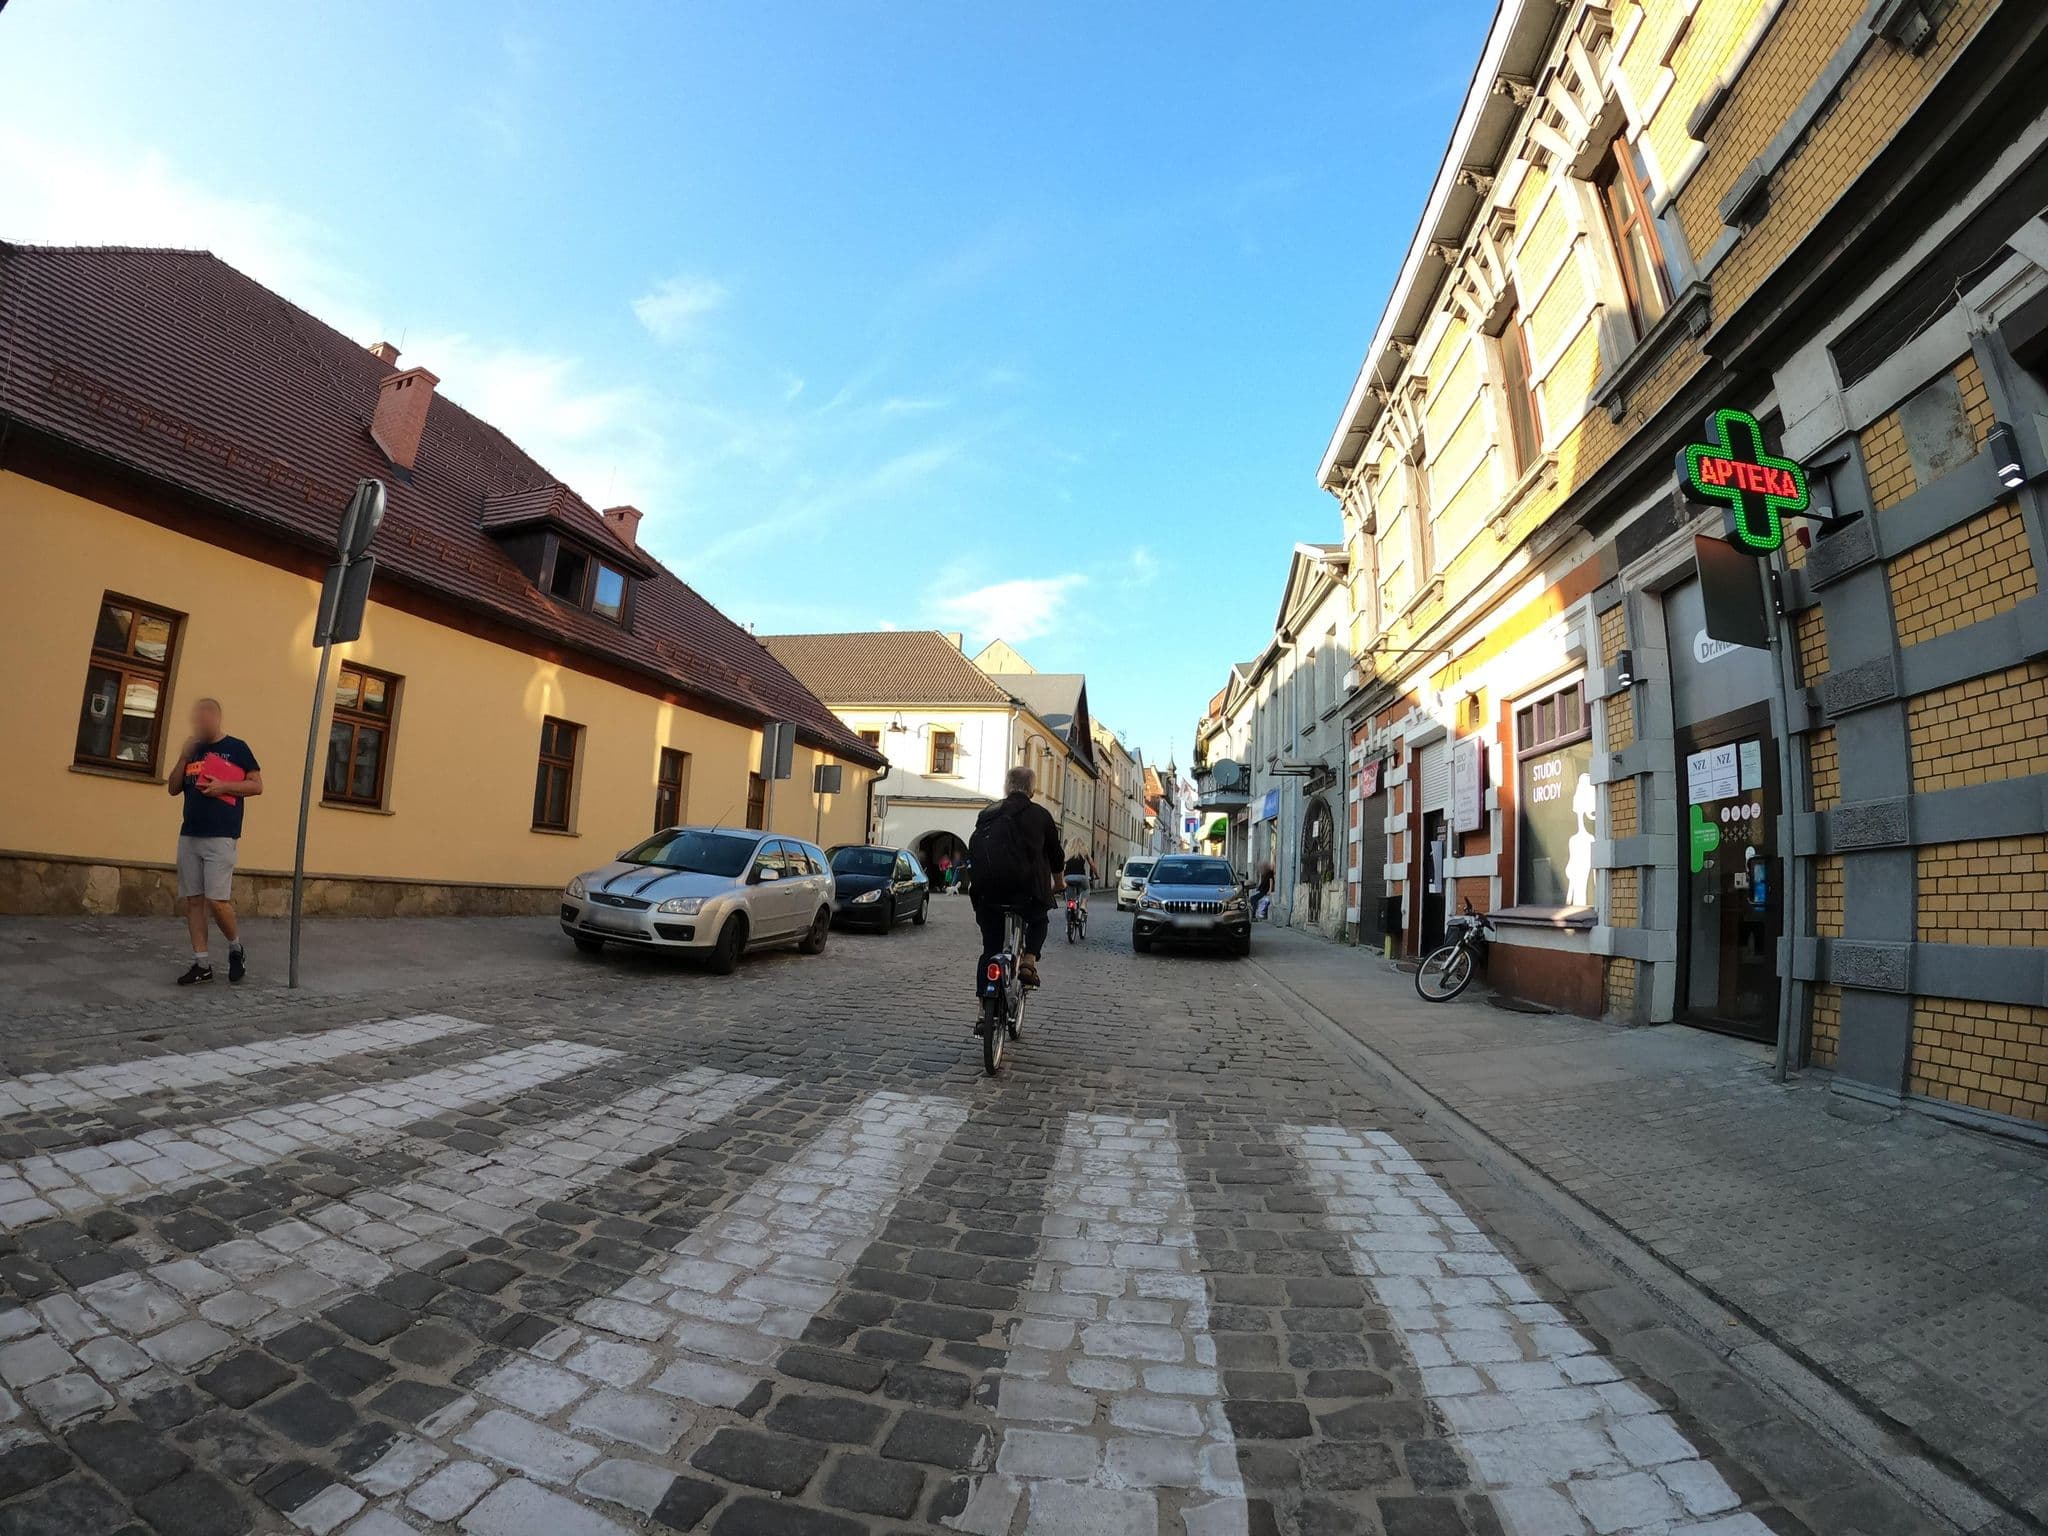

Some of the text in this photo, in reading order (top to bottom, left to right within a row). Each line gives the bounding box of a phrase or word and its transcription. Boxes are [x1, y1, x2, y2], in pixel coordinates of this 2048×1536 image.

[1701, 456, 1799, 499] APTEKA
[1533, 759, 1562, 782] STUDIO
[1533, 781, 1562, 804] URODY
